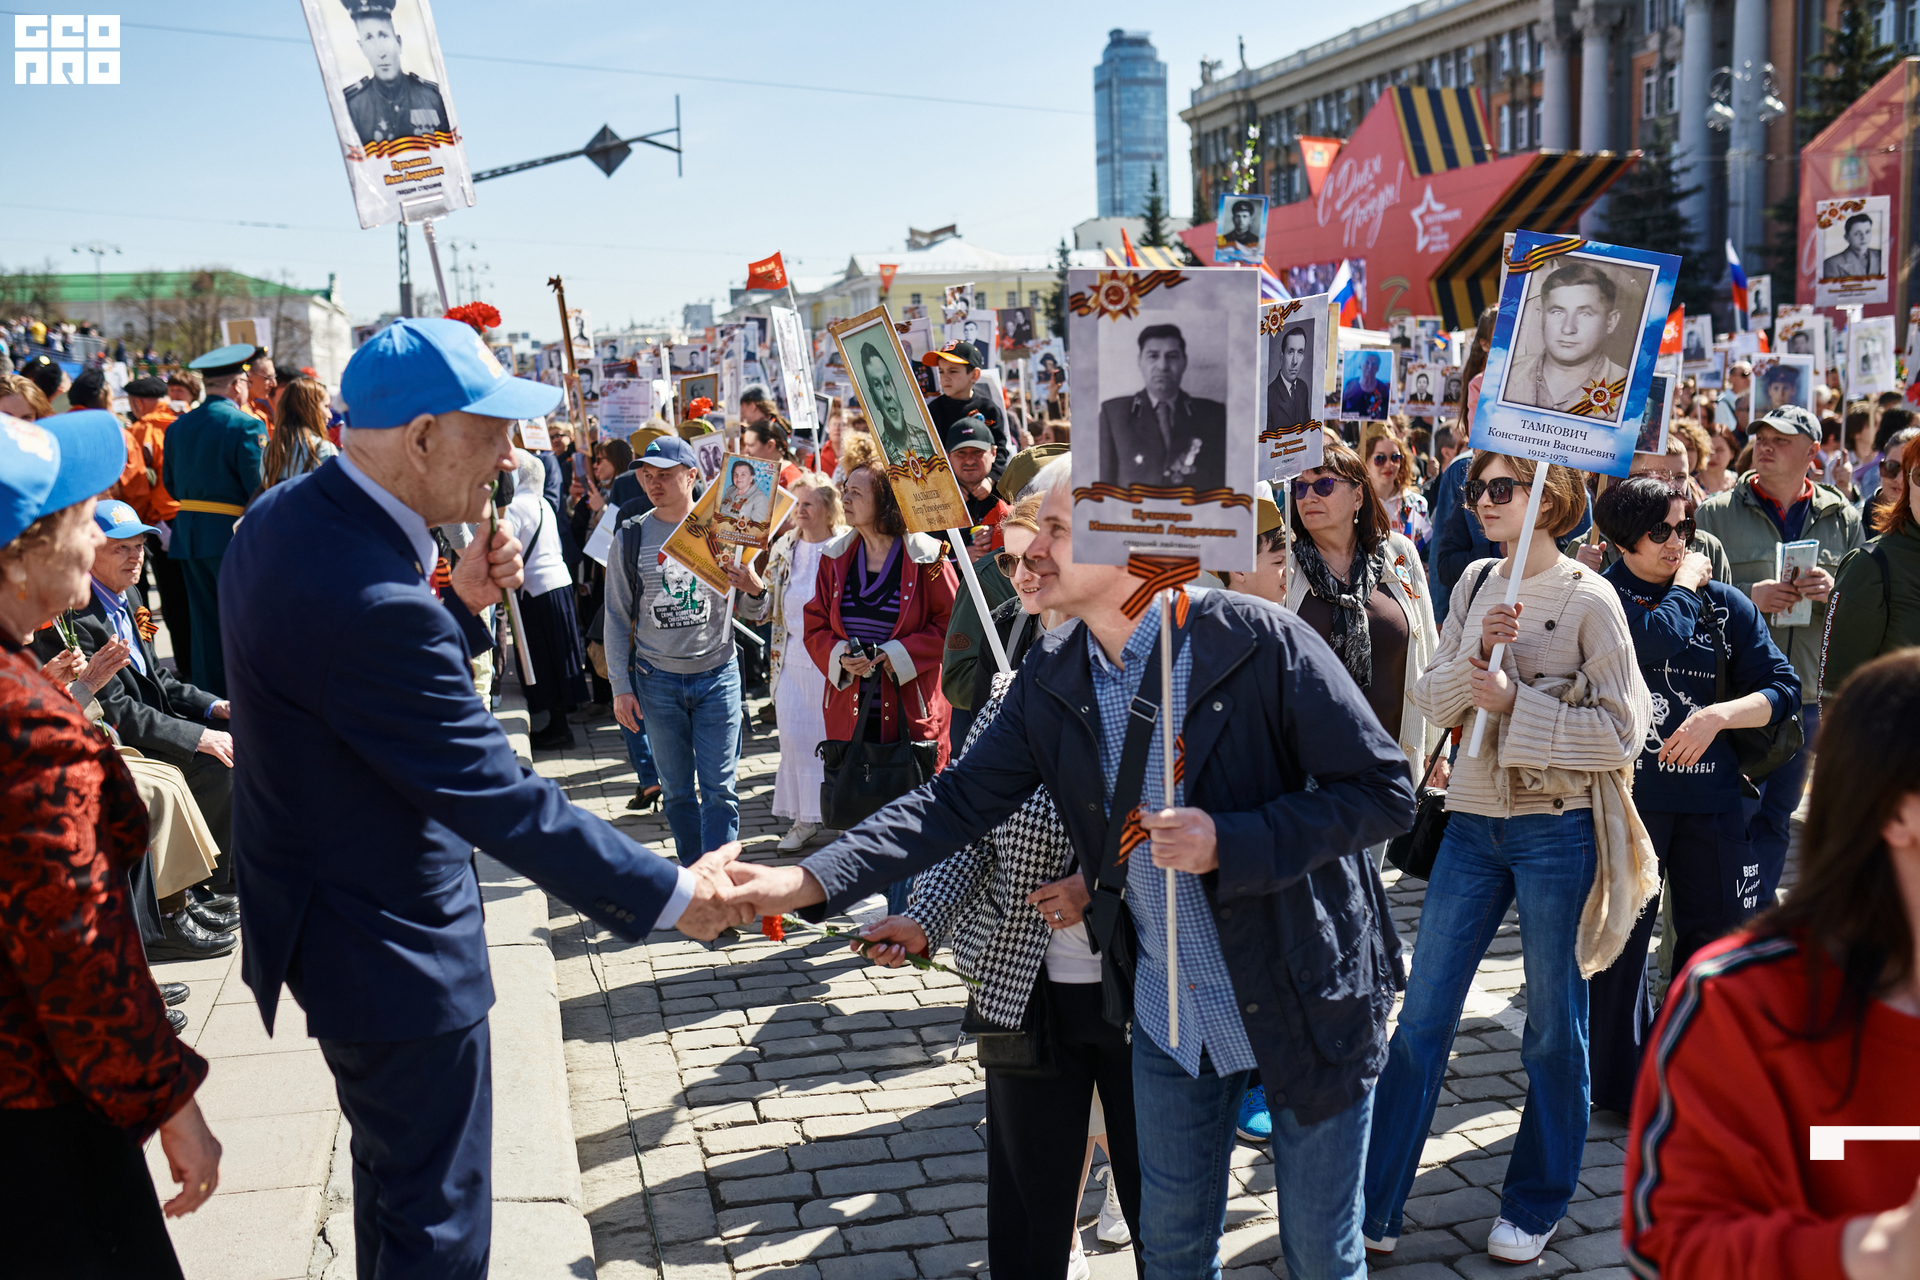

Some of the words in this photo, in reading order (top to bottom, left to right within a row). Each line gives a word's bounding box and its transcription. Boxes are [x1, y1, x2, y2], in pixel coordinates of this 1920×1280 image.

[384, 174, 404, 186] Иван
[404, 166, 444, 182] Андреевич
[1521, 419, 1588, 440] ТАМКОВИЧ
[1487, 427, 1550, 447] Константин
[1553, 439, 1616, 460] Васильевич
[1527, 449, 1569, 463] 1912-1975
[1132, 509, 1192, 522] Кузнецов
[1089, 521, 1164, 535] Иннокентий
[1167, 525, 1237, 538] Андреевич
[1658, 762, 1716, 774] YOURSELF
[1743, 863, 1759, 877] BEST
